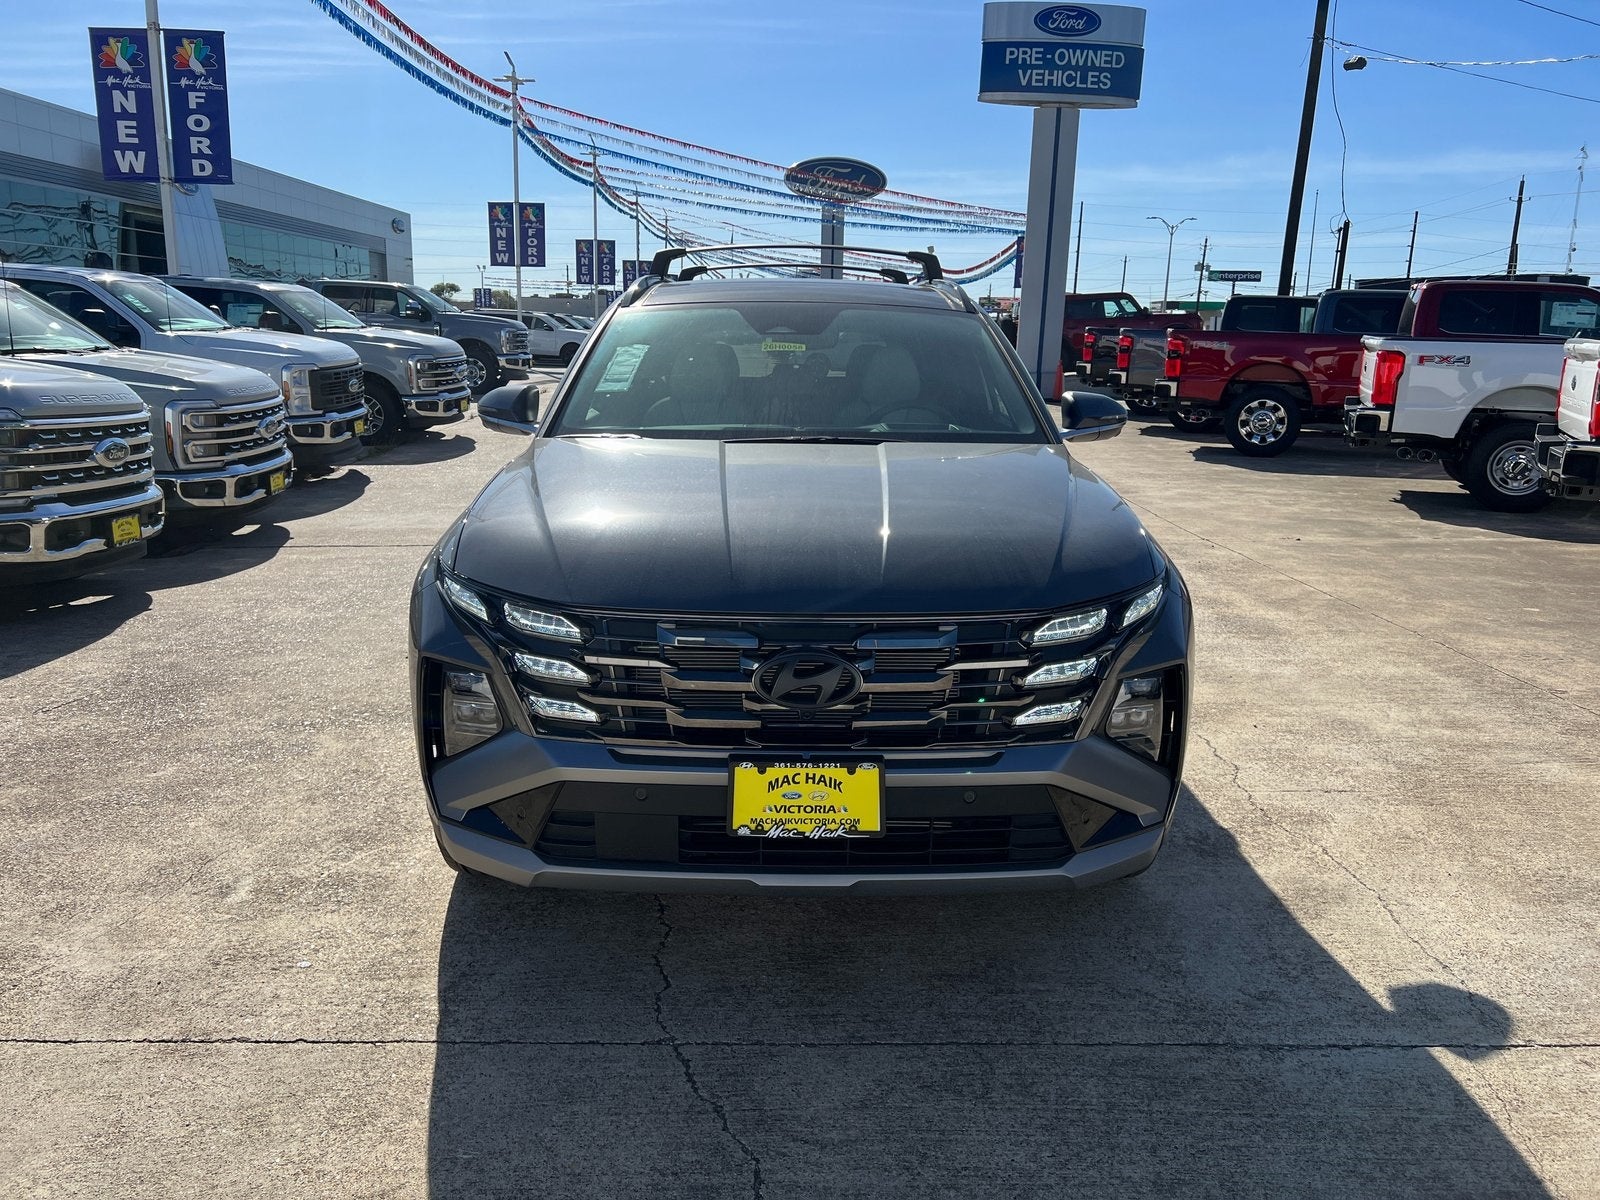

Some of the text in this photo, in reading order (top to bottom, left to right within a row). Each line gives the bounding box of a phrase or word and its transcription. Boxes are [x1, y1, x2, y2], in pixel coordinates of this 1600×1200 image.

[1048, 10, 1087, 30] Ford
[1018, 69, 1112, 89] VEHICLES
[111, 90, 146, 173] NEW
[186, 91, 213, 176] FORD
[496, 227, 509, 263] NEW
[526, 228, 538, 265] FORD
[580, 257, 590, 283] NEW
[602, 257, 610, 284] FORD
[1210, 272, 1261, 280] enterprise
[1417, 354, 1471, 366] FX4
[767, 772, 844, 793] MAC HAIK
[773, 804, 837, 814] VICTORIA
[749, 817, 861, 826] MACHAIKVICTORIA.COM
[765, 824, 850, 839] Mac Haik
